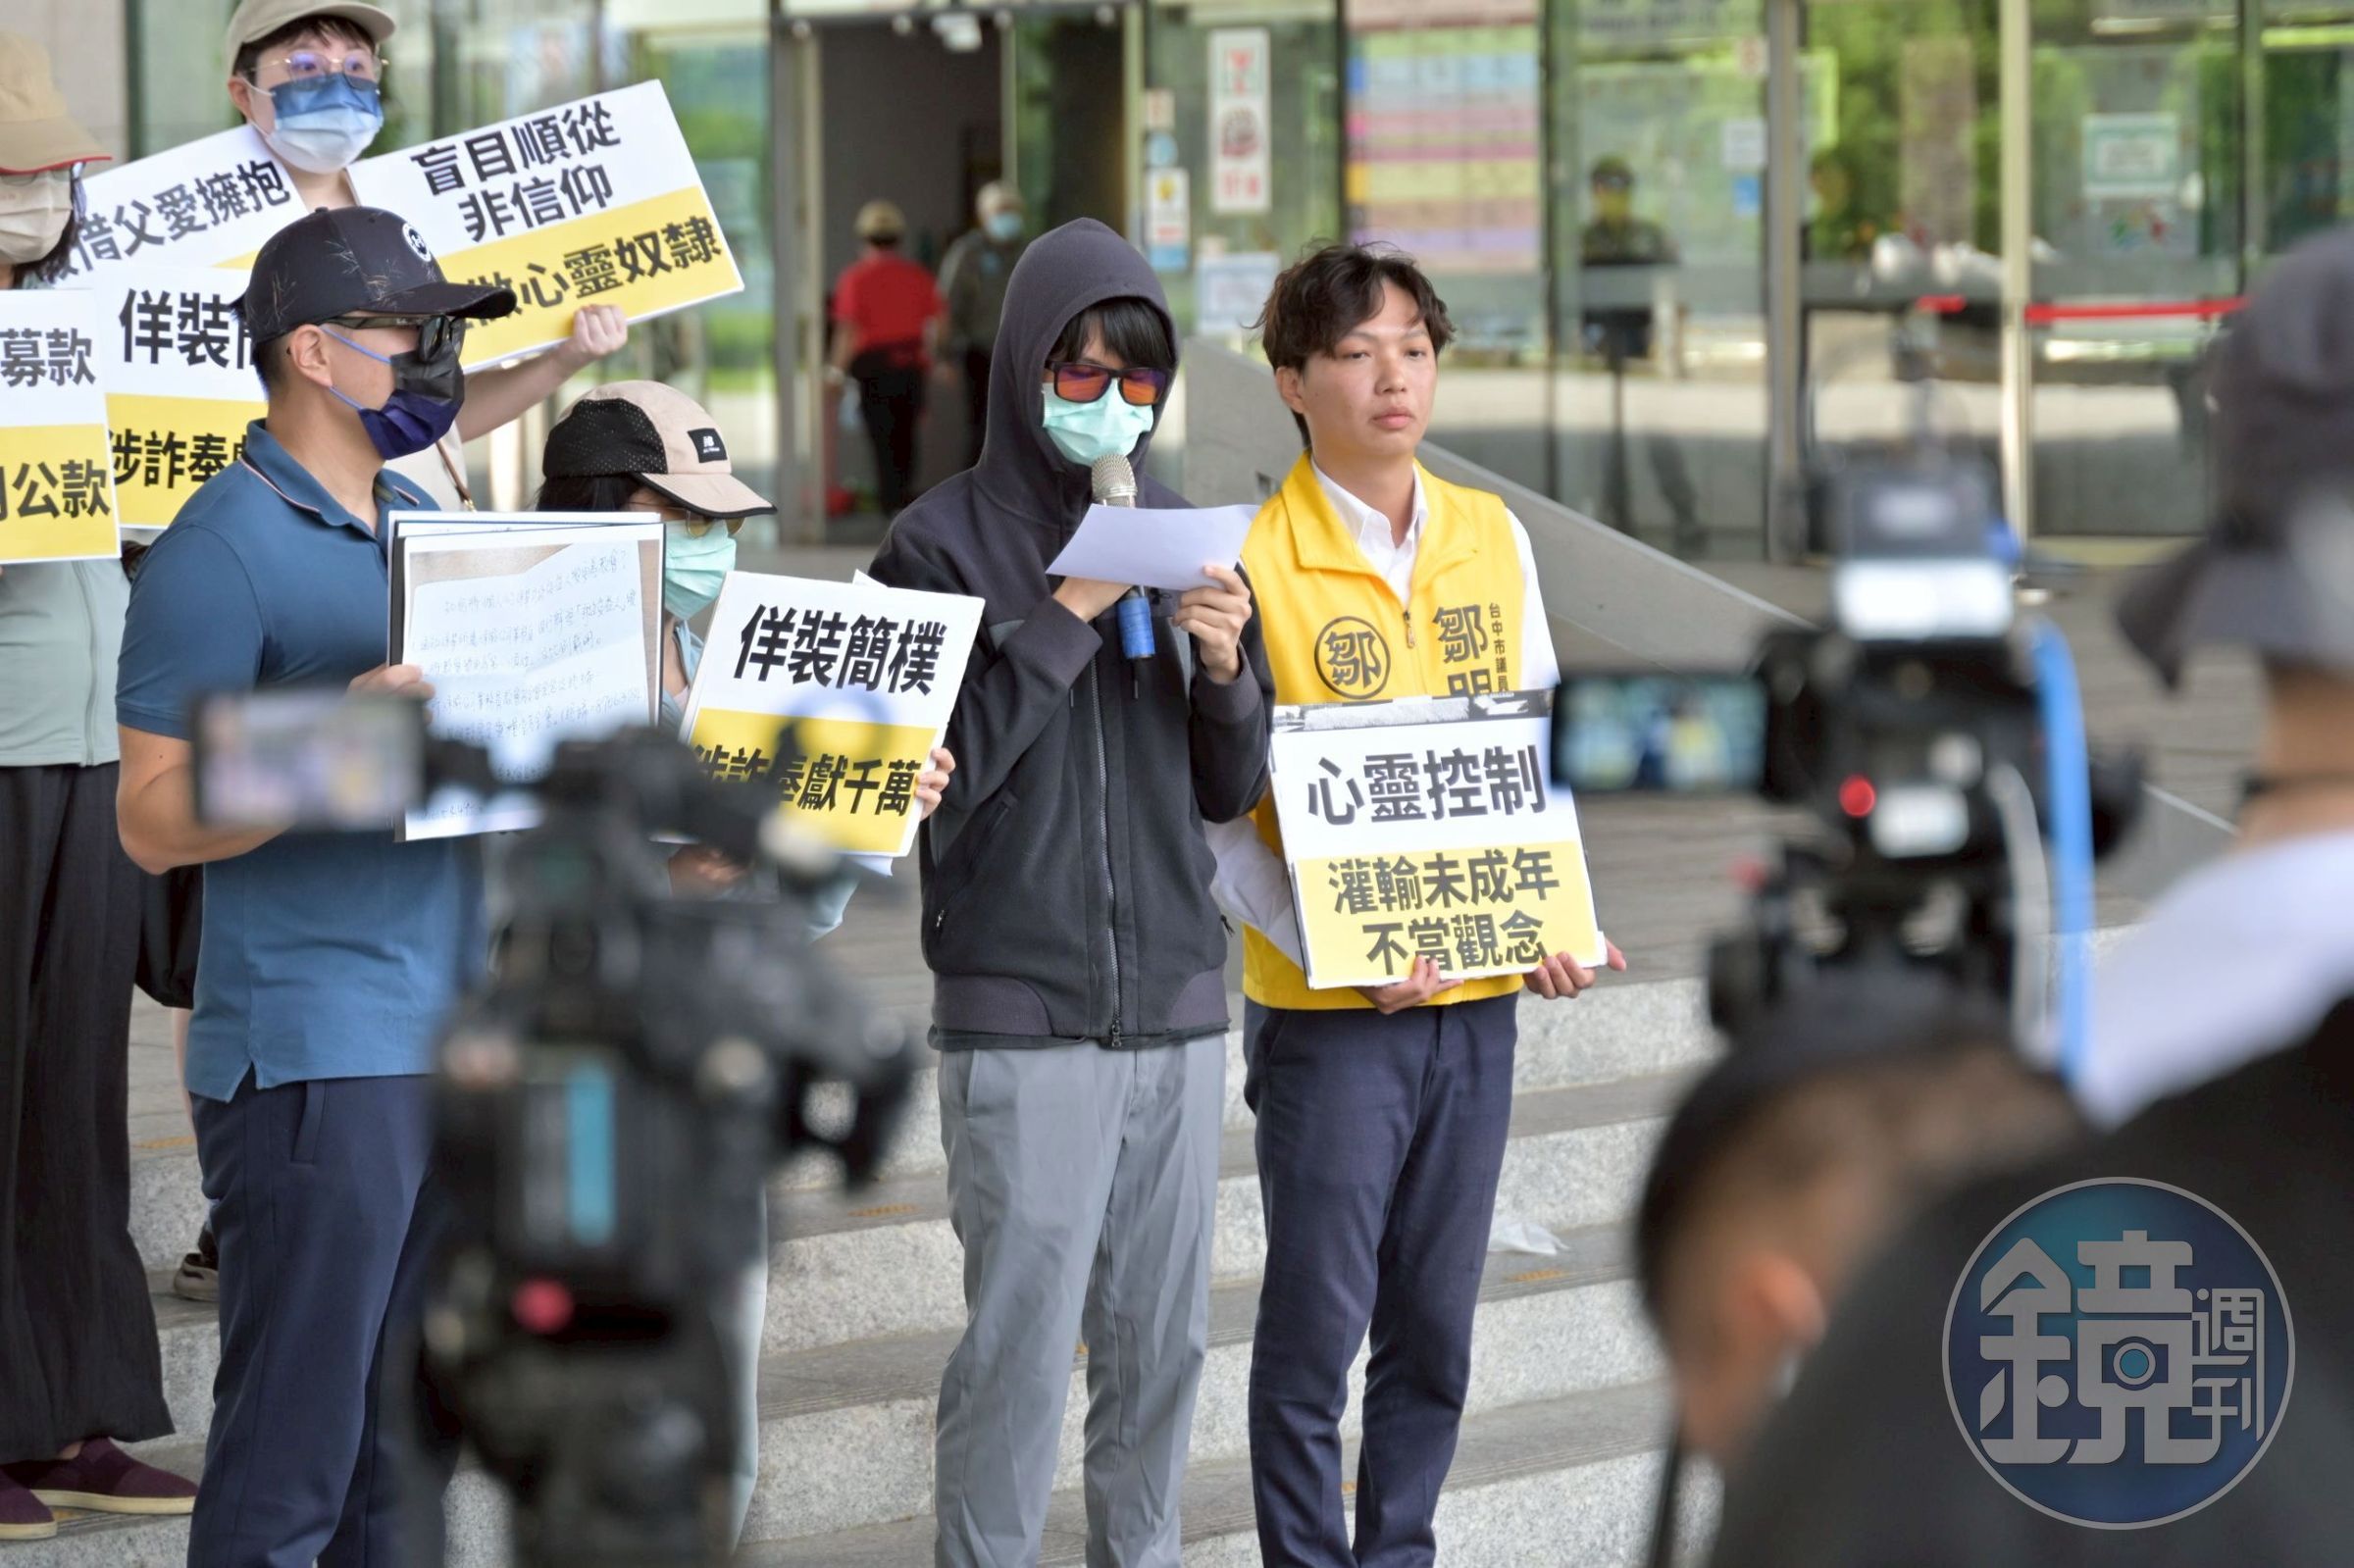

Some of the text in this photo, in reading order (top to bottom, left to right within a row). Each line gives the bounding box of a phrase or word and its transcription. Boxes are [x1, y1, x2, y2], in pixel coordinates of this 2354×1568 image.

[410, 100, 621, 196] 盲目順從
[58, 160, 291, 280] 借父愛擁抱
[458, 164, 614, 242] 非信仰
[467, 216, 722, 329] 心靈奴隸
[119, 288, 257, 370] 佯裝
[0, 459, 110, 522] 公款
[108, 429, 247, 489] 涉詐奉
[734, 604, 947, 696] 佯裝簡樸
[1324, 631, 1381, 688] 鄒
[1489, 602, 1510, 692] 台中市議員
[1307, 744, 1547, 826] 心靈控制
[1327, 847, 1560, 915] 灌輸未成年
[1362, 910, 1547, 976] 不當觀念
